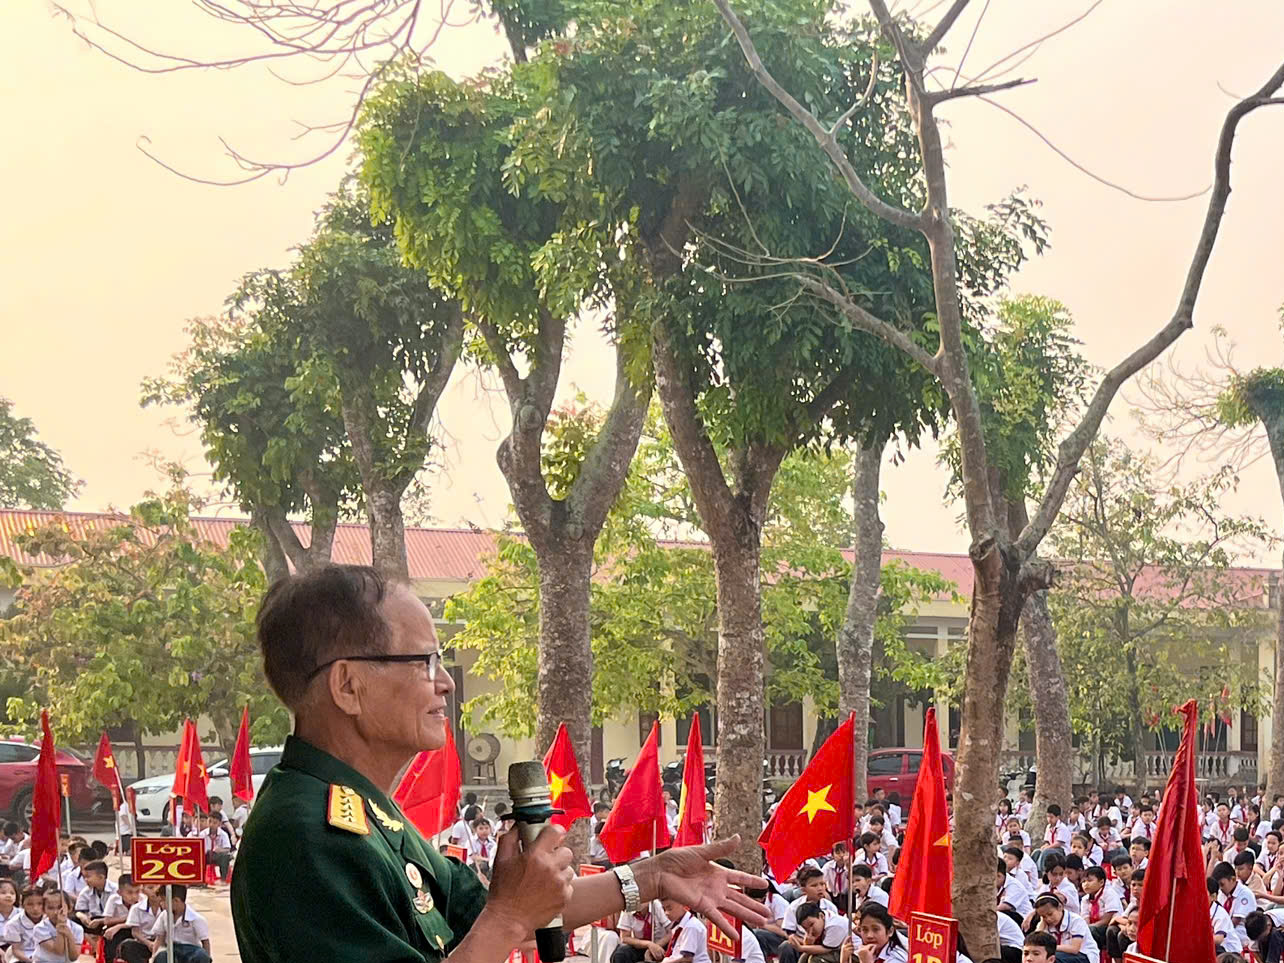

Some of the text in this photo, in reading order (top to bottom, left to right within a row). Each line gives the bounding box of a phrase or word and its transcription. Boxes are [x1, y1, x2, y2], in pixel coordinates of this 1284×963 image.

[145, 843, 192, 856] Lớp
[141, 859, 196, 879] 2C
[916, 924, 943, 949] Lớp
